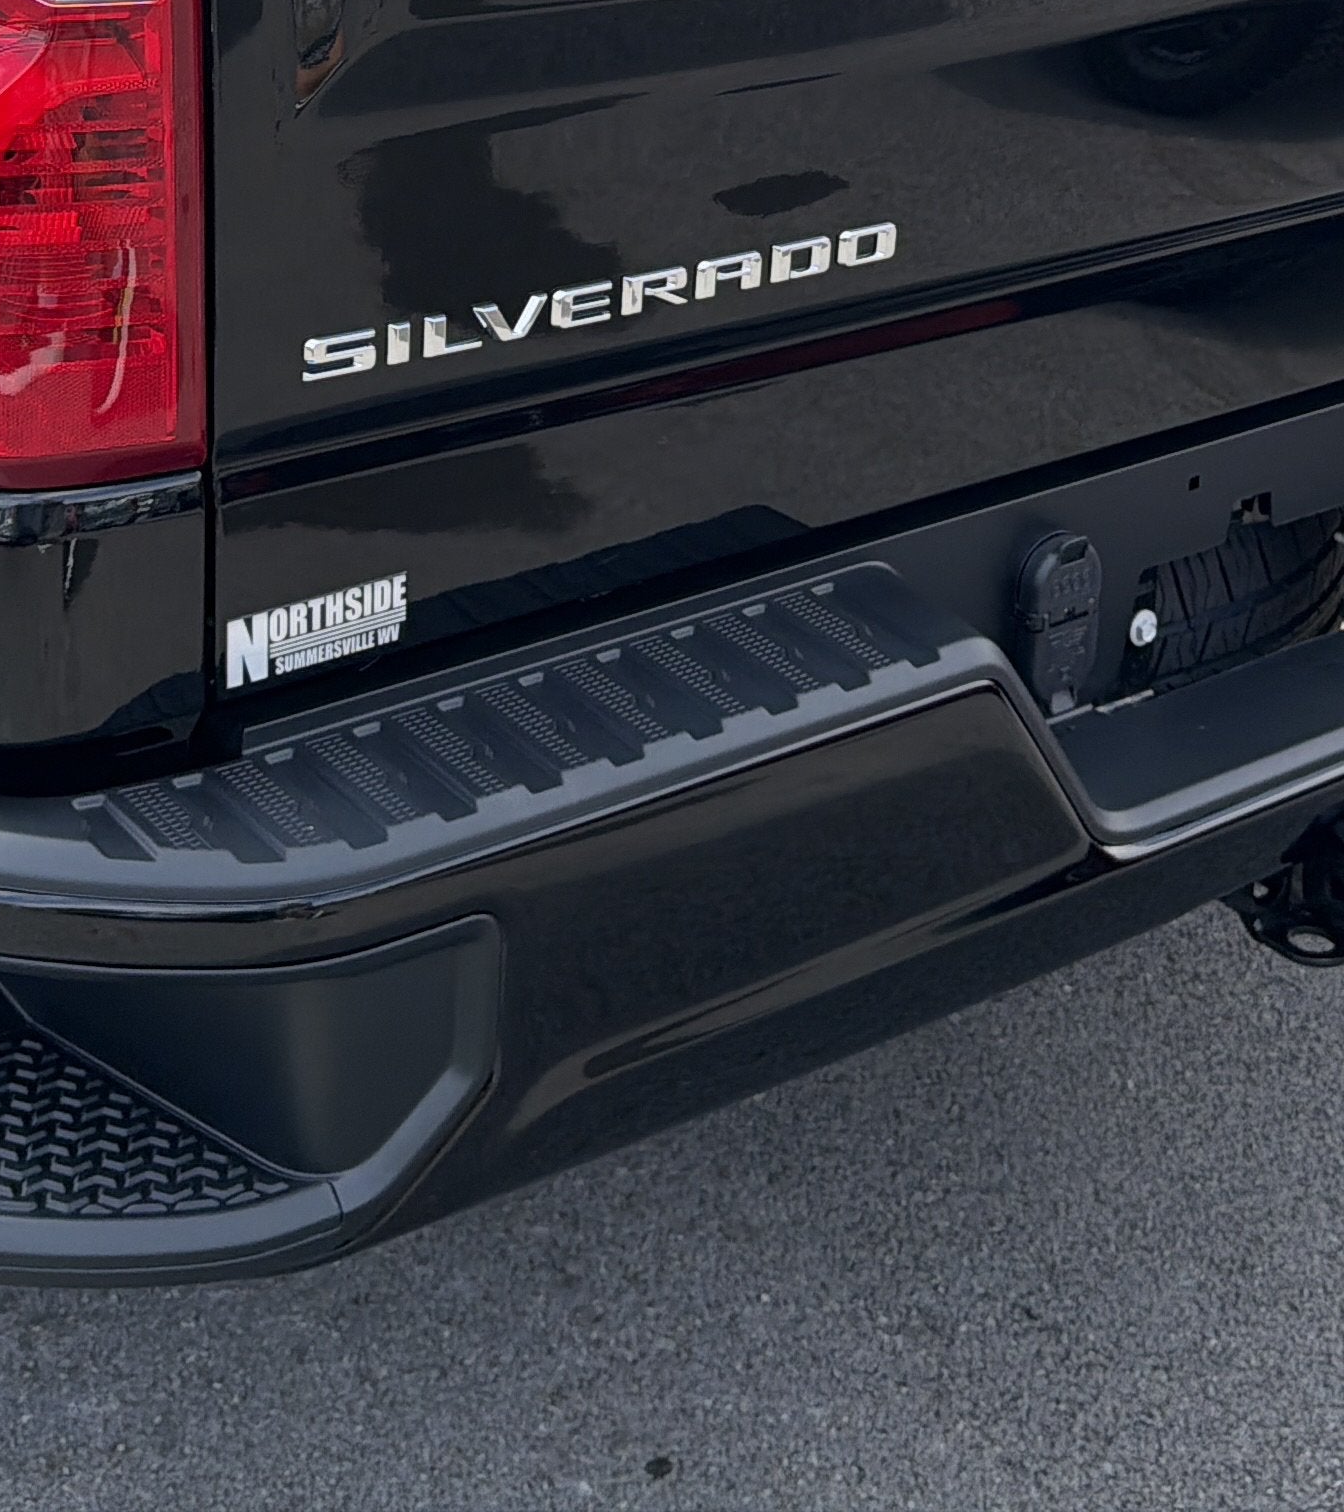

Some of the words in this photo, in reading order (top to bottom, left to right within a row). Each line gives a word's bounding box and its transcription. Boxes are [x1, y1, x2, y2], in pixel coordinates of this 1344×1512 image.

[301, 221, 898, 382] SILVERADO
[226, 573, 408, 690] NORTHSIDE
[274, 629, 376, 676] SUMMERSVILLE
[377, 622, 401, 646] WV
